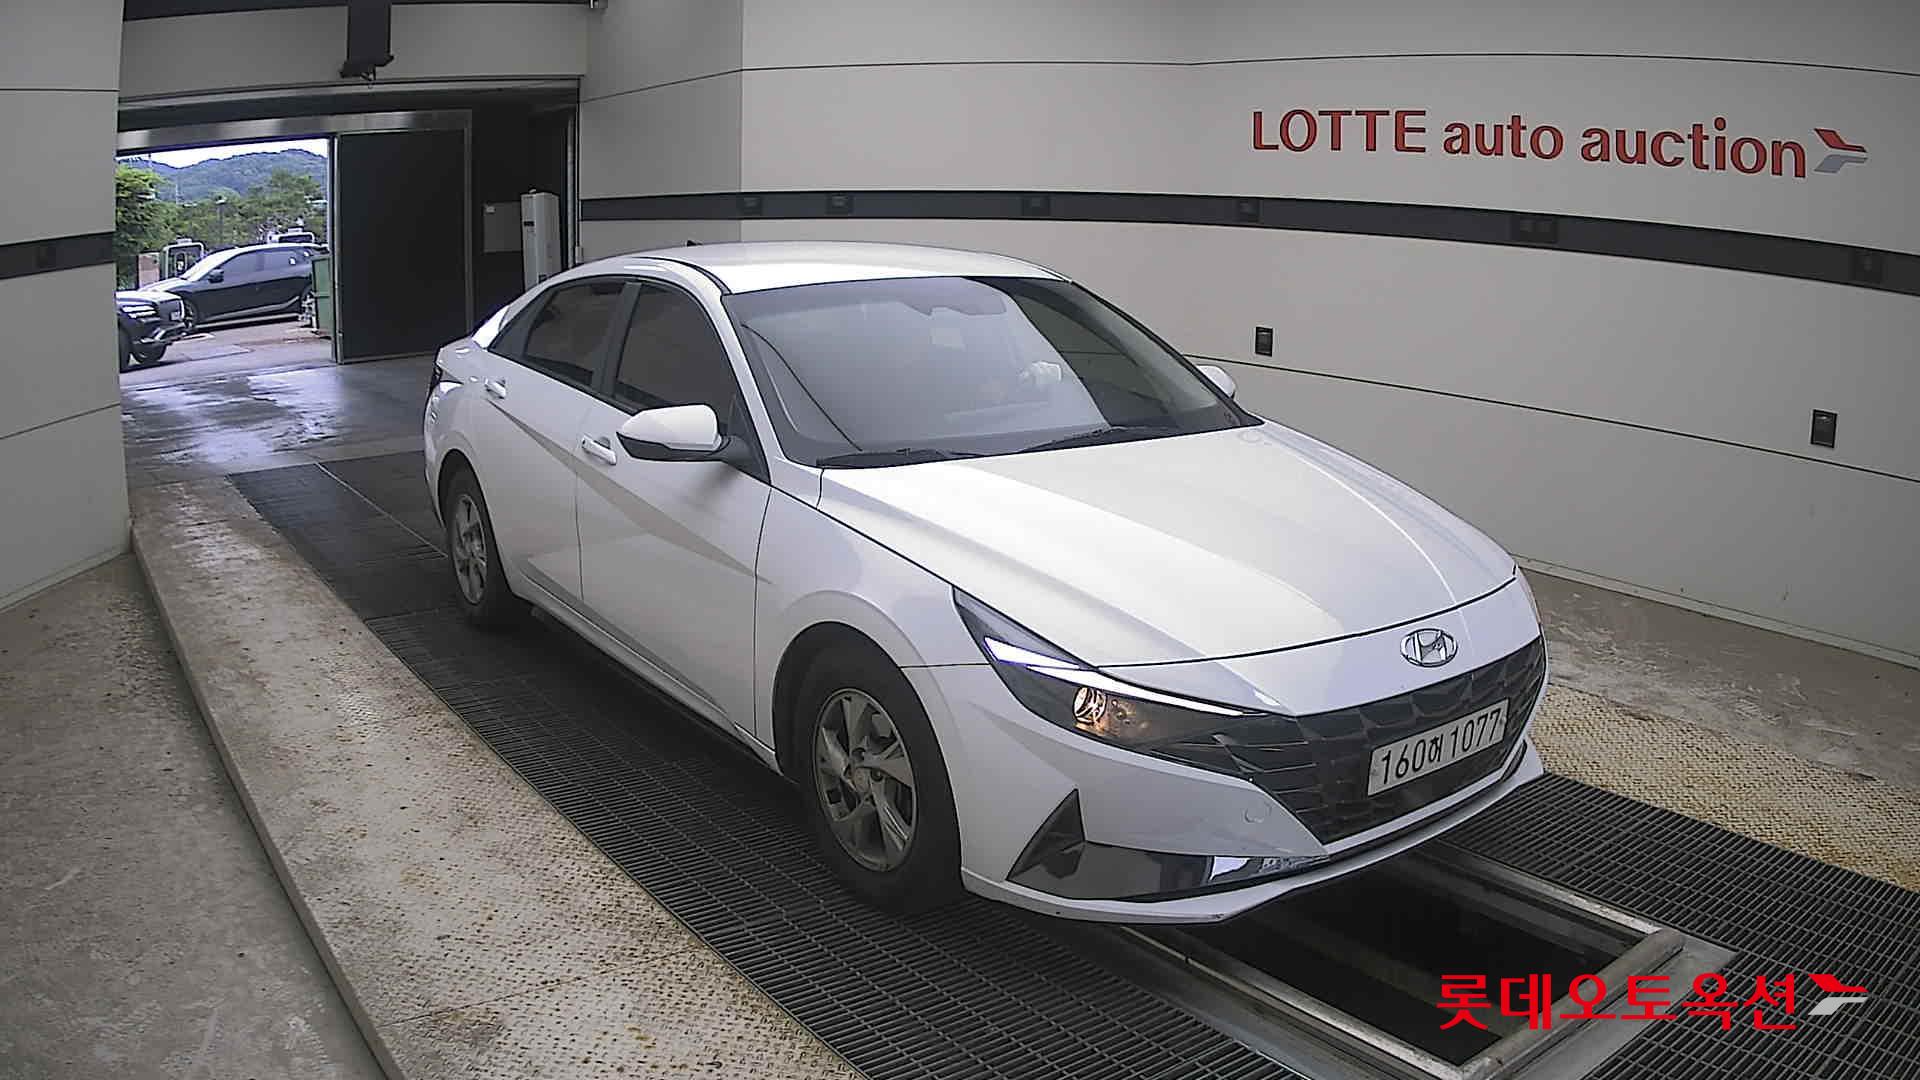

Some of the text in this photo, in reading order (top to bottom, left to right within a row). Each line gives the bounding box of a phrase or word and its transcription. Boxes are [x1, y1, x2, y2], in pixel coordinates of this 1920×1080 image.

[1253, 110, 1807, 178] LOTTE auto auction
[1381, 708, 1502, 785] 160허 1077
